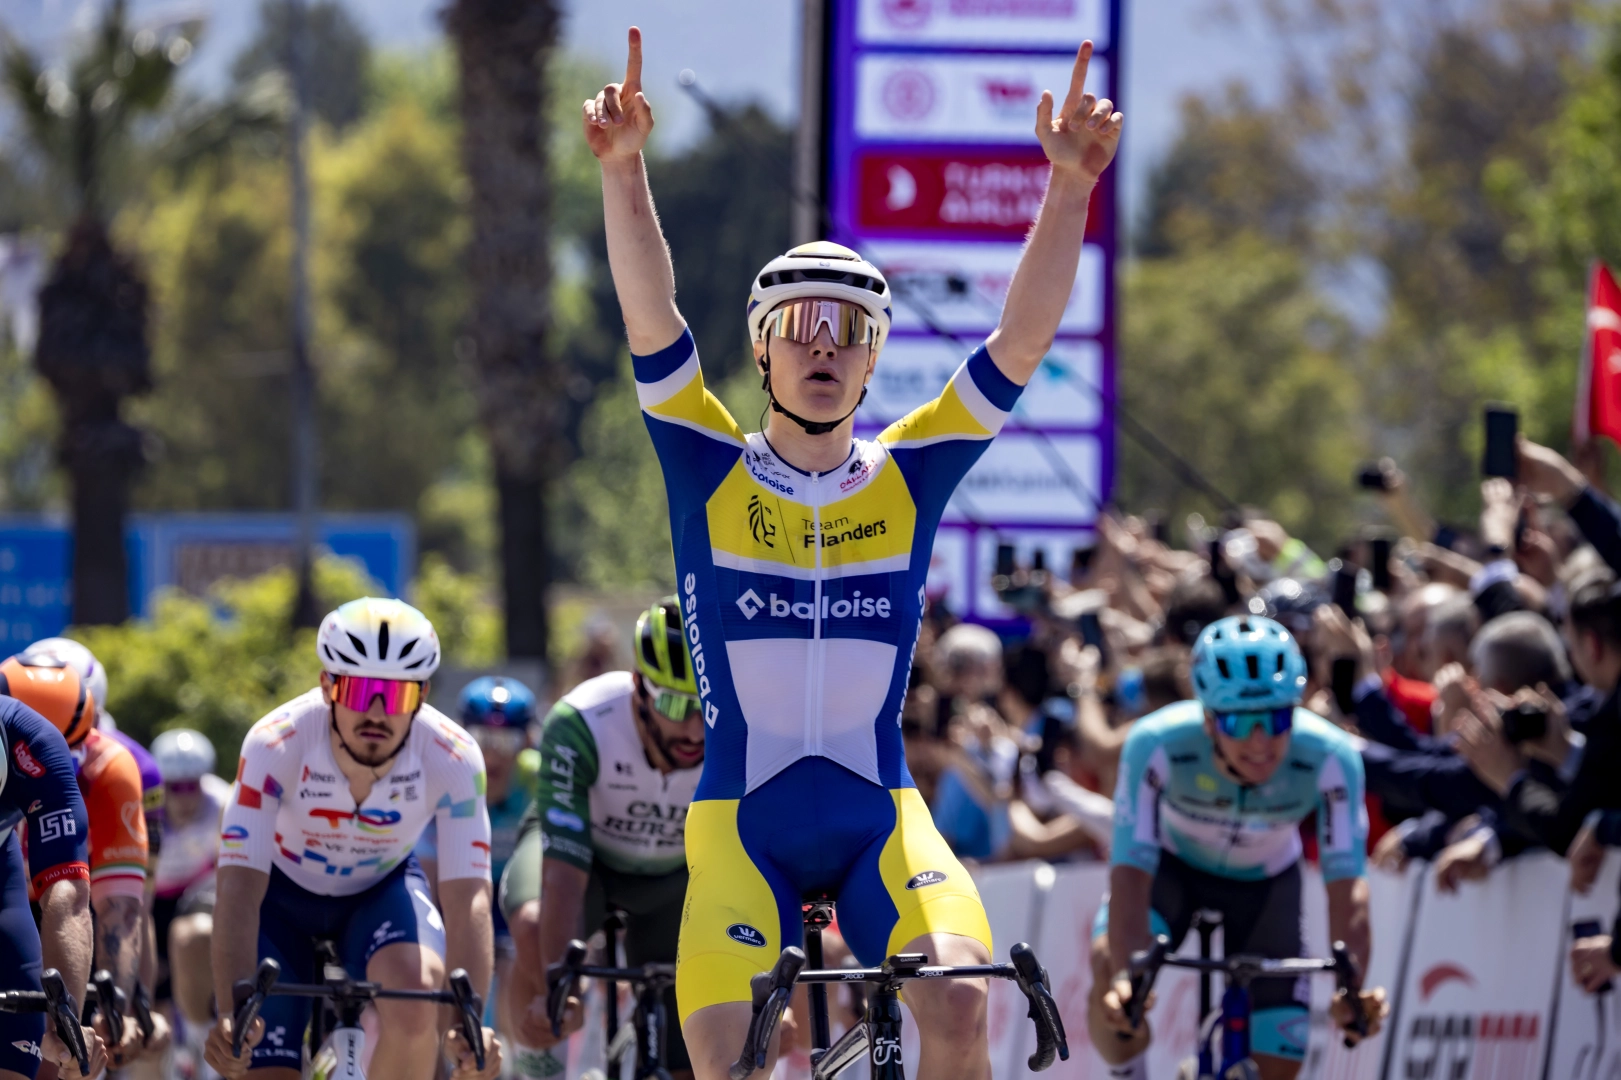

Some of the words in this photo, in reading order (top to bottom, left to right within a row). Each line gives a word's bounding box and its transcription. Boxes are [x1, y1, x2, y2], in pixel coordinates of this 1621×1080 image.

[801, 516, 849, 531] Team
[804, 519, 886, 549] Flanders
[770, 590, 891, 620] baloise
[684, 572, 712, 699] baloise
[604, 816, 685, 839] RURA
[733, 934, 762, 945] vermarc
